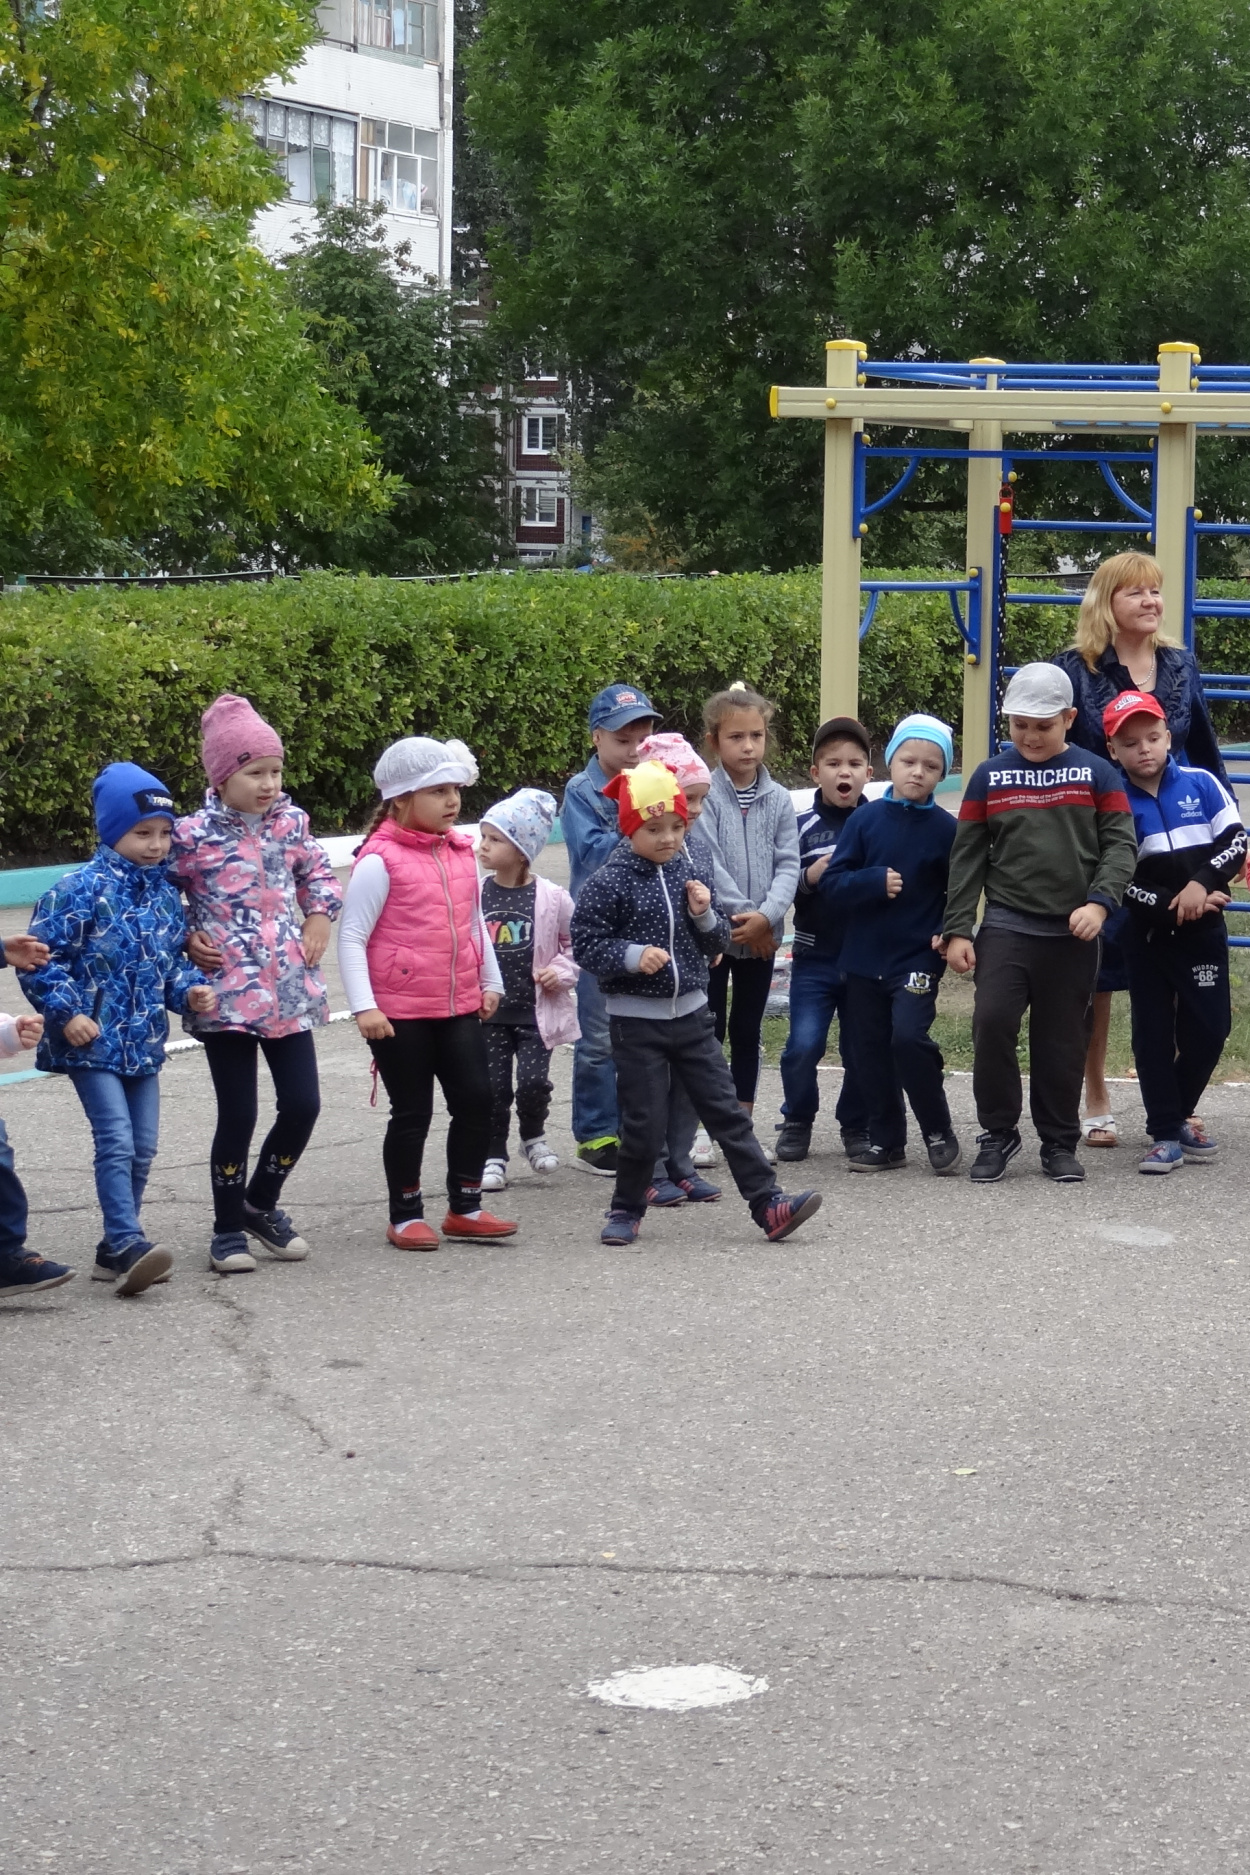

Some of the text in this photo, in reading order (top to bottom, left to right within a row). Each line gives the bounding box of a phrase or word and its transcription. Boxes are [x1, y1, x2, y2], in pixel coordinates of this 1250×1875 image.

[988, 767, 1092, 786] PETRICHOR
[1180, 810, 1203, 819] adidas
[485, 920, 532, 945] YAY!
[1192, 964, 1219, 973] HUDSON
[1199, 970, 1214, 982] 68
